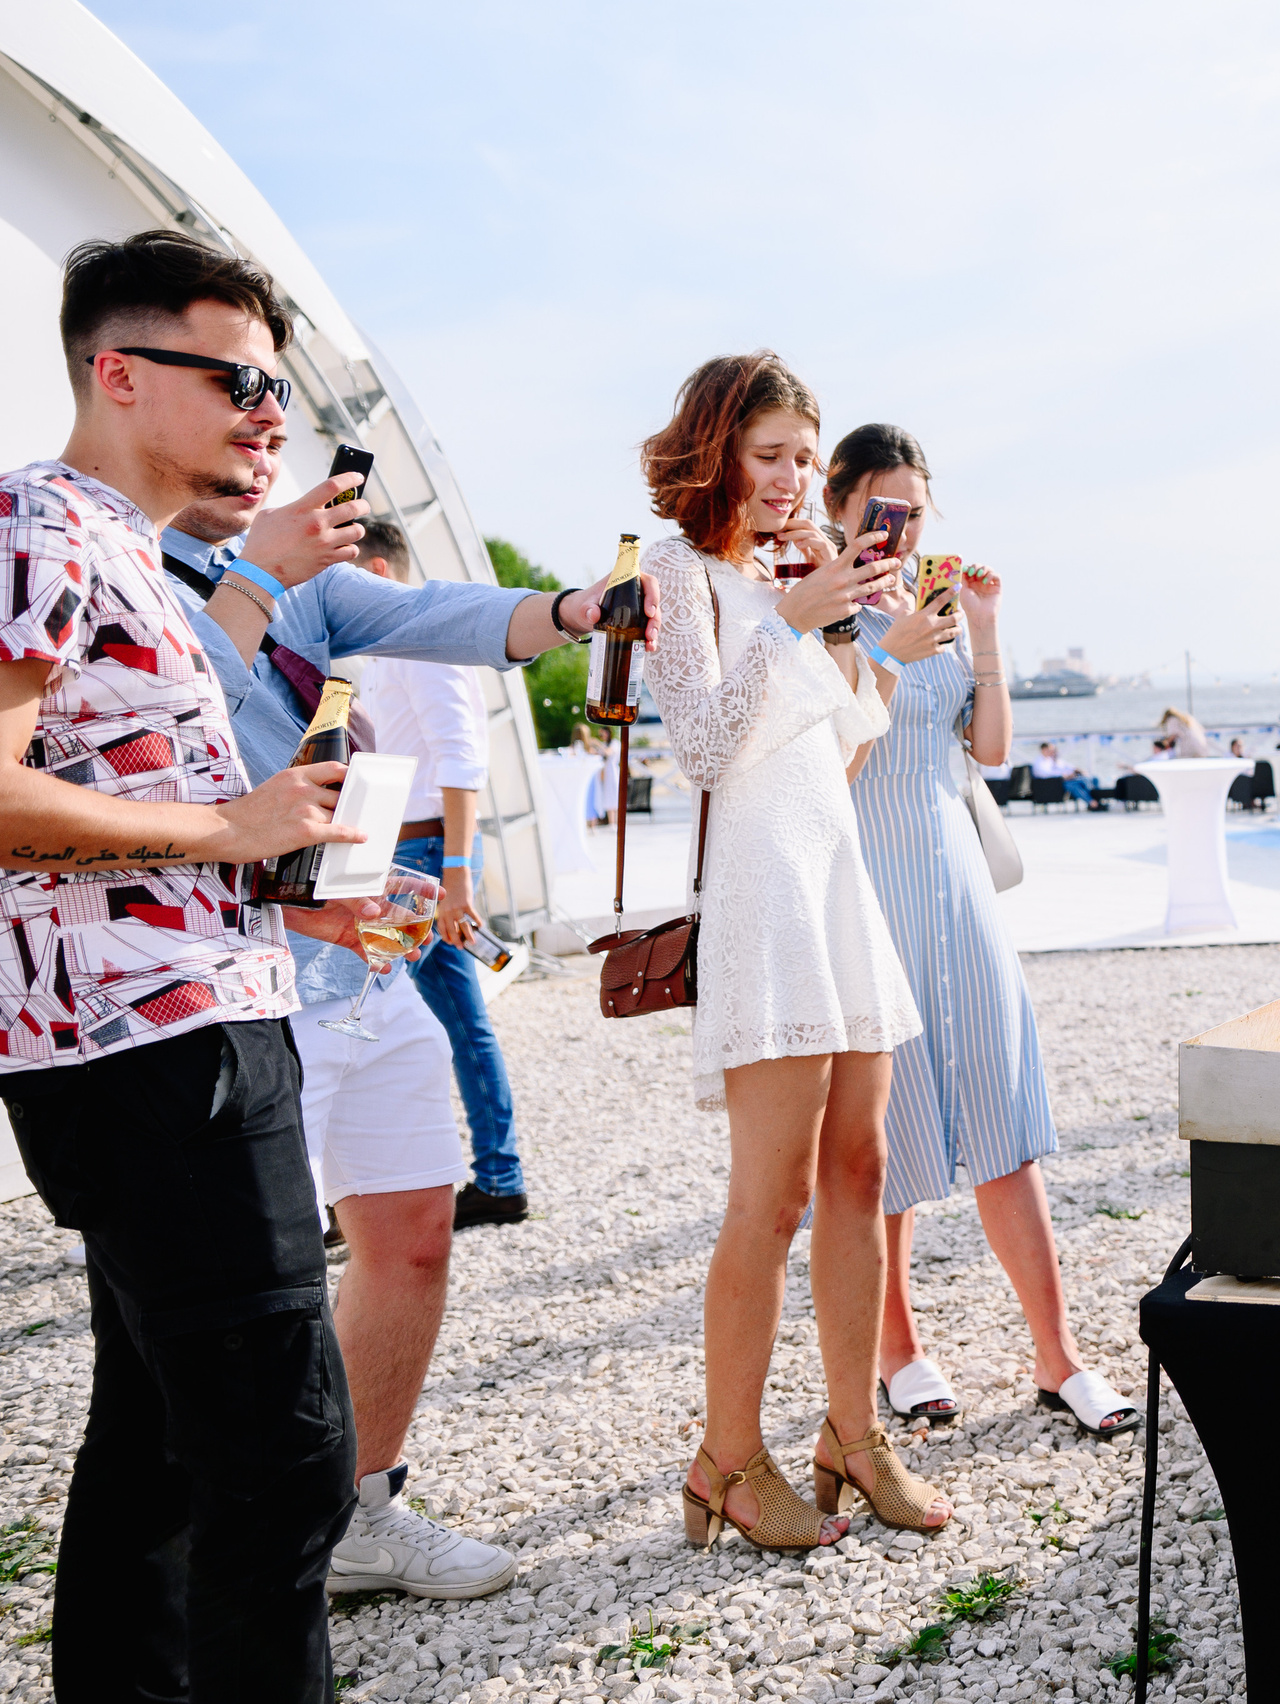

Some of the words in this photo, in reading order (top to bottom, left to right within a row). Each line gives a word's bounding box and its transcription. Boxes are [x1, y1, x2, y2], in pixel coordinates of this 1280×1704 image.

[10, 845, 77, 863] الموت
[75, 848, 120, 866] حتى
[126, 842, 186, 863] سأحبك
